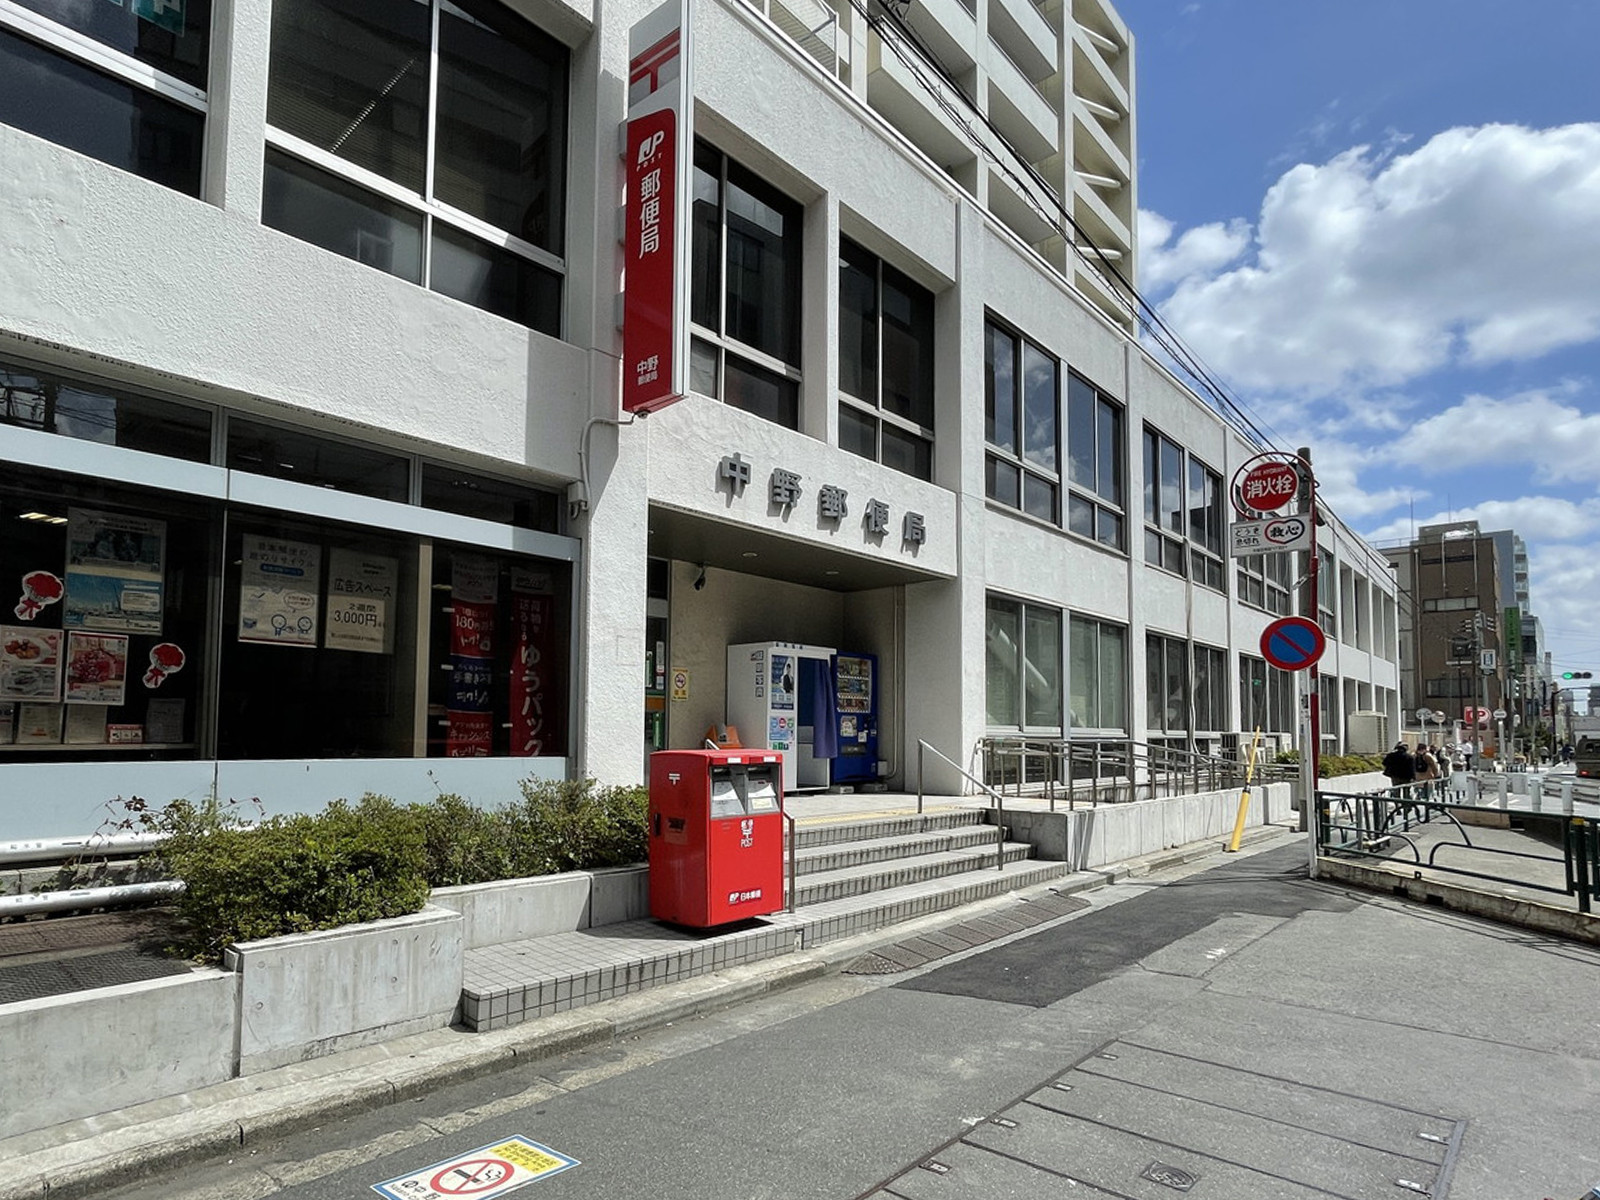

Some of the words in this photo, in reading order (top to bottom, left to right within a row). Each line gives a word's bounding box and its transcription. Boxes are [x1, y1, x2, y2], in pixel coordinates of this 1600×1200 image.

[636, 154, 662, 172] POST
[639, 168, 661, 260] 郵便局
[637, 354, 659, 374] 中野
[1246, 474, 1293, 499] 消火栓
[720, 452, 926, 546] 中野郵便局
[1271, 525, 1299, 538] 救心
[334, 578, 392, 597] 広告スペース
[334, 610, 377, 627] 3,000円
[521, 644, 544, 756] ゆうパック
[740, 838, 753, 848] POST
